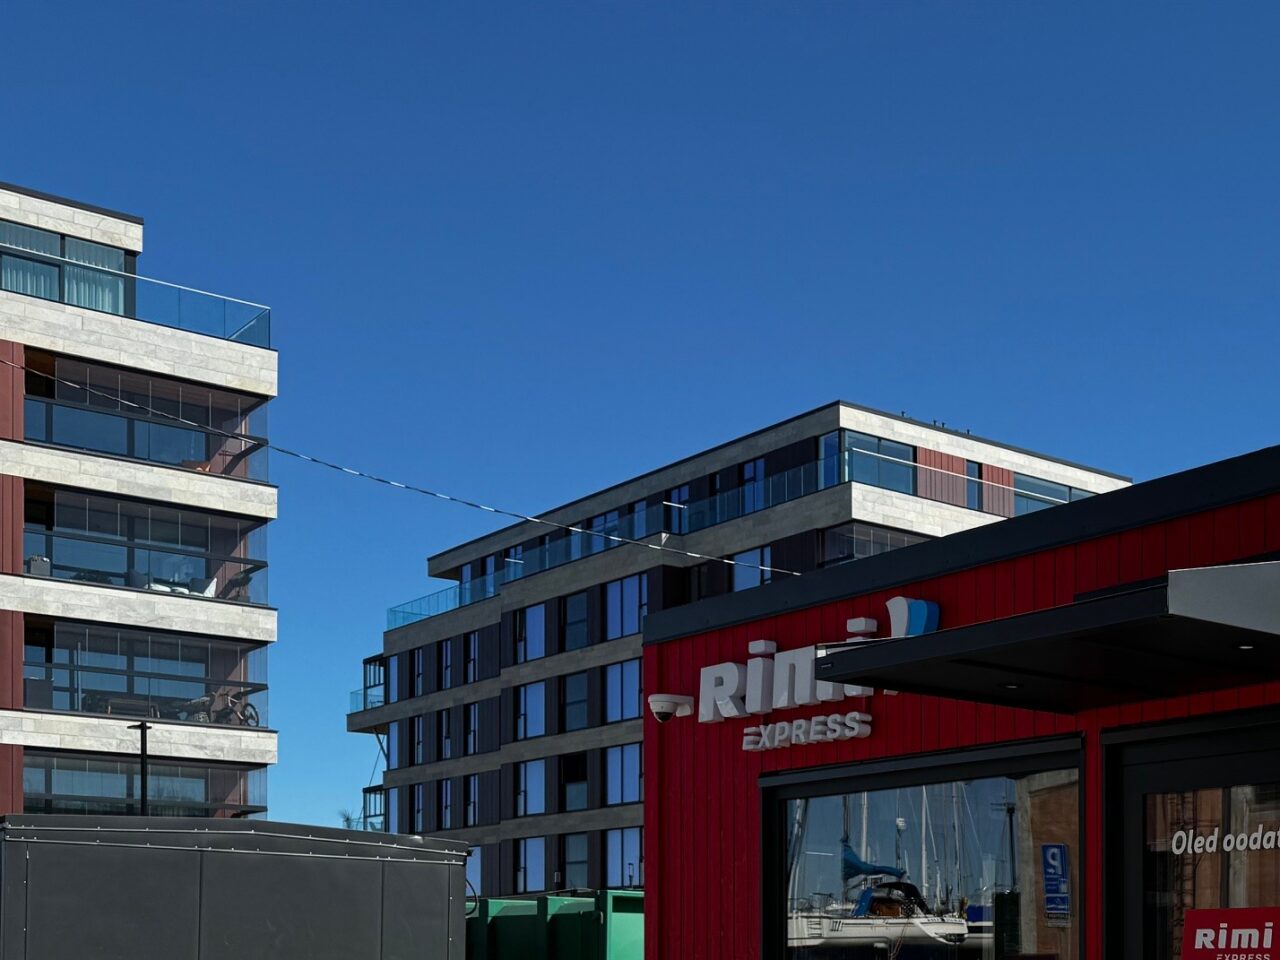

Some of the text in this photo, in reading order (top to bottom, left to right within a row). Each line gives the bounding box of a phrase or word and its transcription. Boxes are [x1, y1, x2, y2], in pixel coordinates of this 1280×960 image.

[743, 712, 872, 751] EXPRESS
[1171, 827, 1219, 855] Oled
[1194, 922, 1274, 949] Rimi
